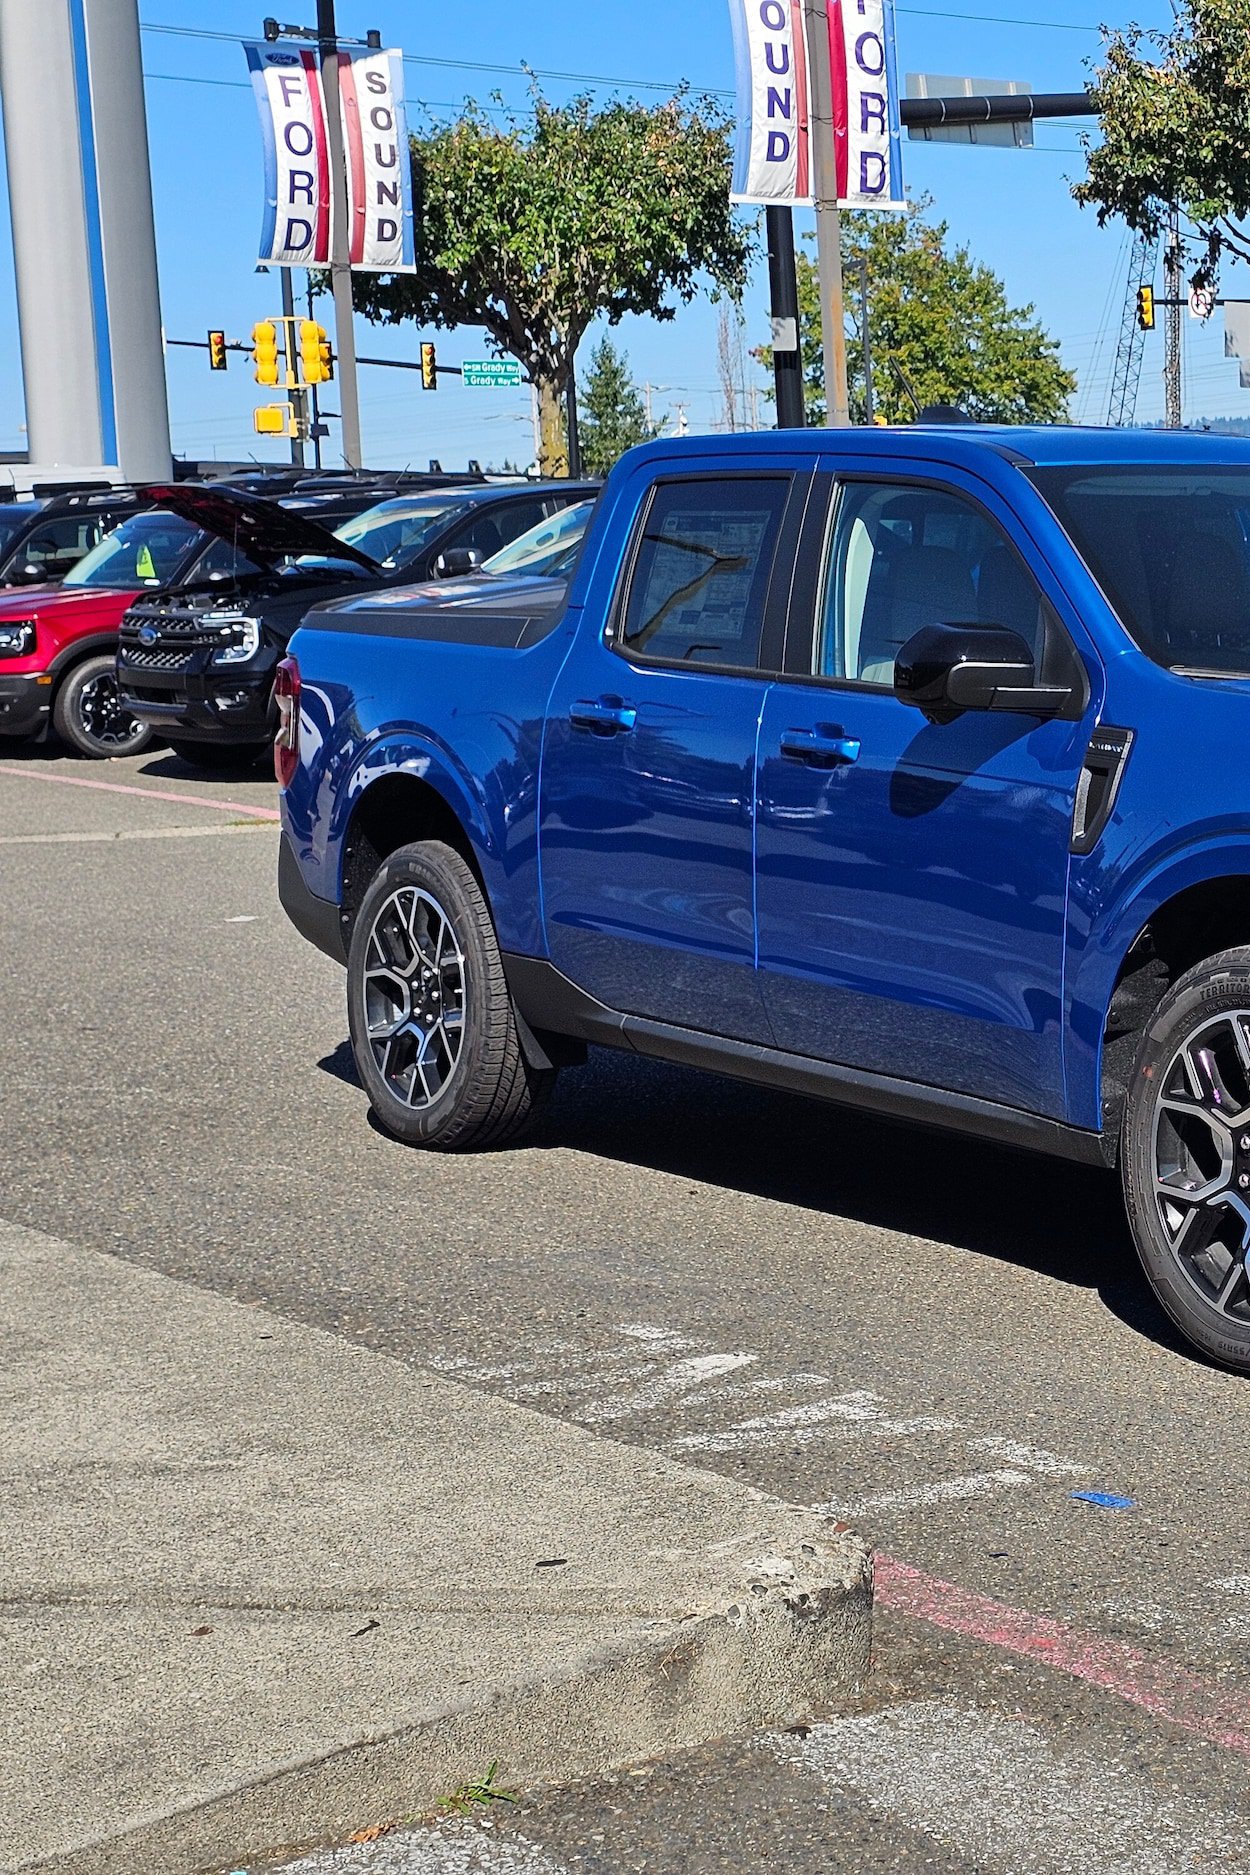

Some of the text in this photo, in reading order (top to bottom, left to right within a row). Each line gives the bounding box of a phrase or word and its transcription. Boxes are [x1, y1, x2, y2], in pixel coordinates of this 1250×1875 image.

[277, 75, 315, 251] FORD
[365, 72, 398, 242] SOUND
[759, 0, 791, 162] OUND
[855, 0, 886, 194] ORD
[470, 375, 496, 387] Grady
[482, 362, 505, 374] Grady
